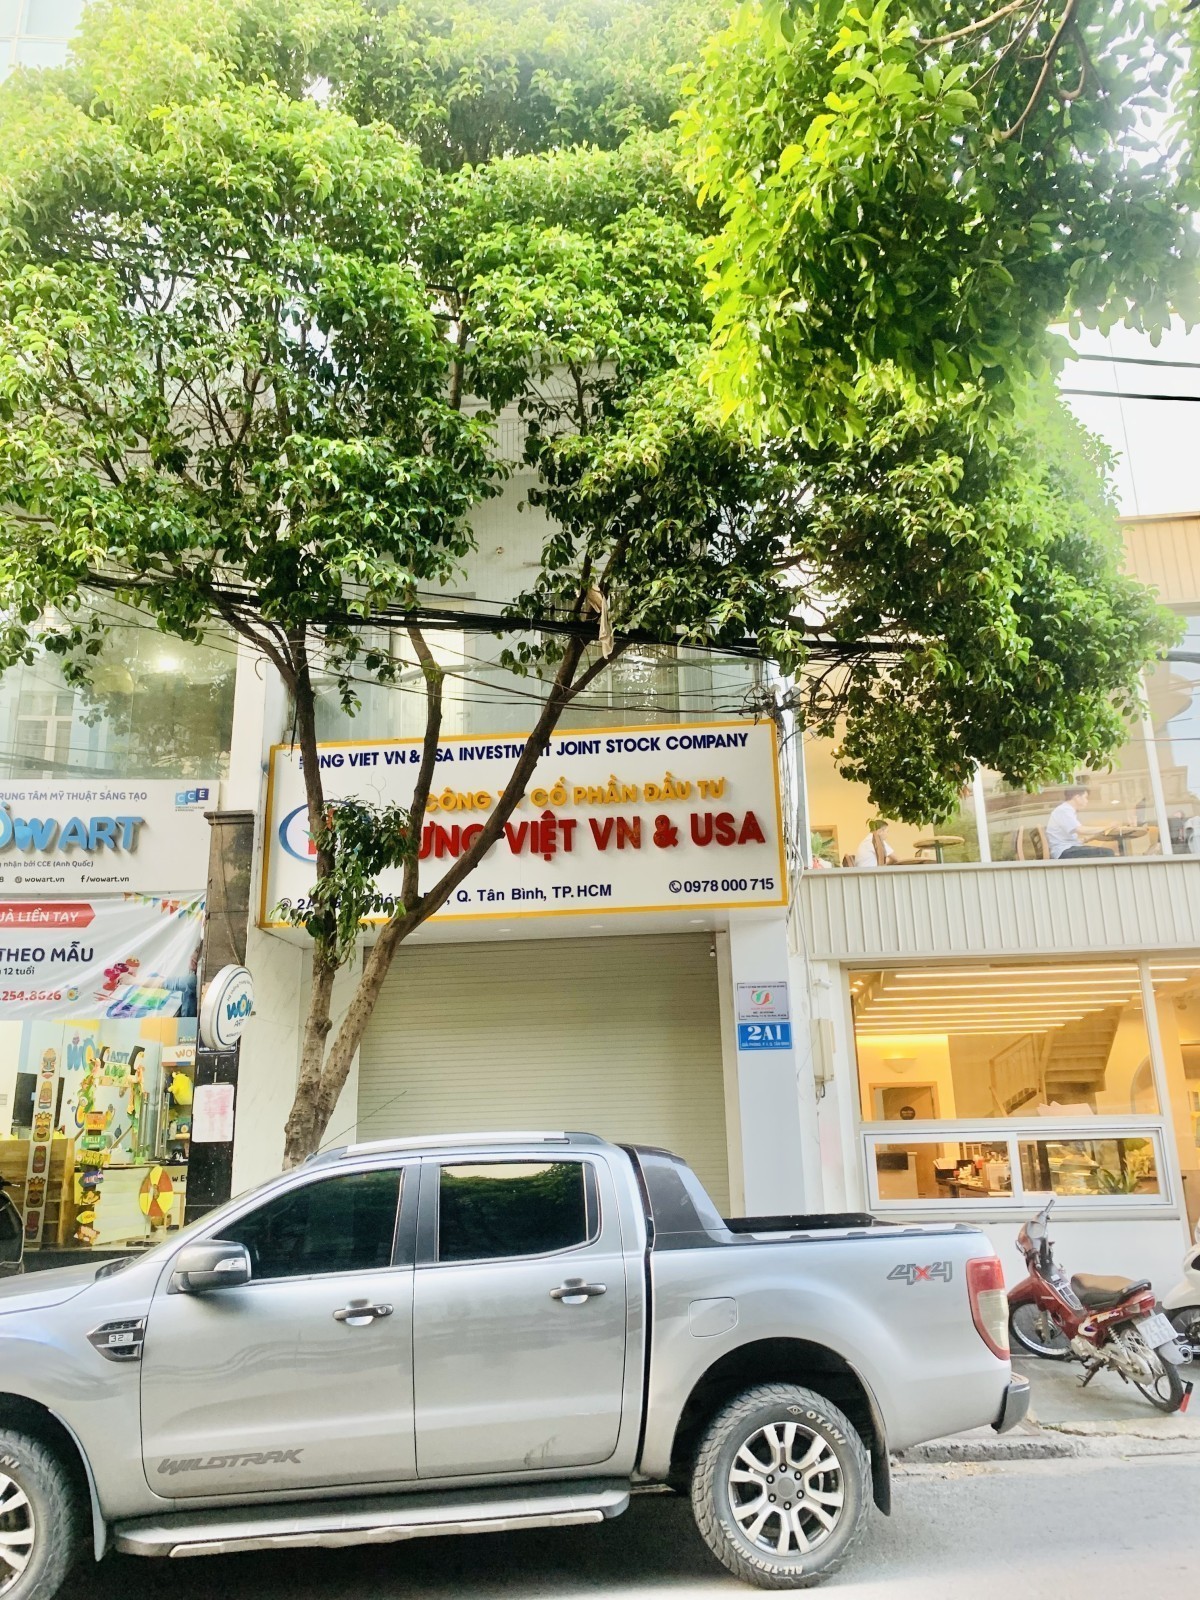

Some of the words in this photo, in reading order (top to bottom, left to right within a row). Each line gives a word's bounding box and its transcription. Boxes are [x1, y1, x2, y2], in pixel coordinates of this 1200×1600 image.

[349, 752, 379, 767] VIET
[384, 750, 405, 765] VN
[409, 749, 420, 763] &
[434, 747, 454, 762] SA
[556, 740, 601, 756] JOINT
[606, 737, 660, 753] STOCK
[666, 733, 748, 750] COMPANY
[28, 790, 47, 801] TÂM
[50, 790, 64, 801] MỸ
[67, 790, 97, 802] THUẬT
[100, 790, 126, 801] SÁNG
[128, 791, 148, 802] TẠO
[177, 789, 207, 803] CCE
[425, 786, 492, 813] CÔNG
[530, 776, 568, 808] CỔ
[573, 773, 638, 806] PHẦN
[643, 771, 691, 803] ĐẦU
[697, 777, 726, 799] TƯ
[504, 810, 577, 862] VIỆT
[588, 815, 642, 851] VN
[653, 814, 679, 849] &
[690, 810, 766, 847] USA
[456, 889, 472, 903] Q.
[477, 889, 505, 902] Tân
[511, 886, 547, 901] Bình,
[53, 911, 79, 923] TAY
[50, 941, 94, 962] MẪU
[4, 967, 14, 976] 12
[805, 1409, 847, 1446] OTANI
[157, 1448, 304, 1476] WILDTRAK
